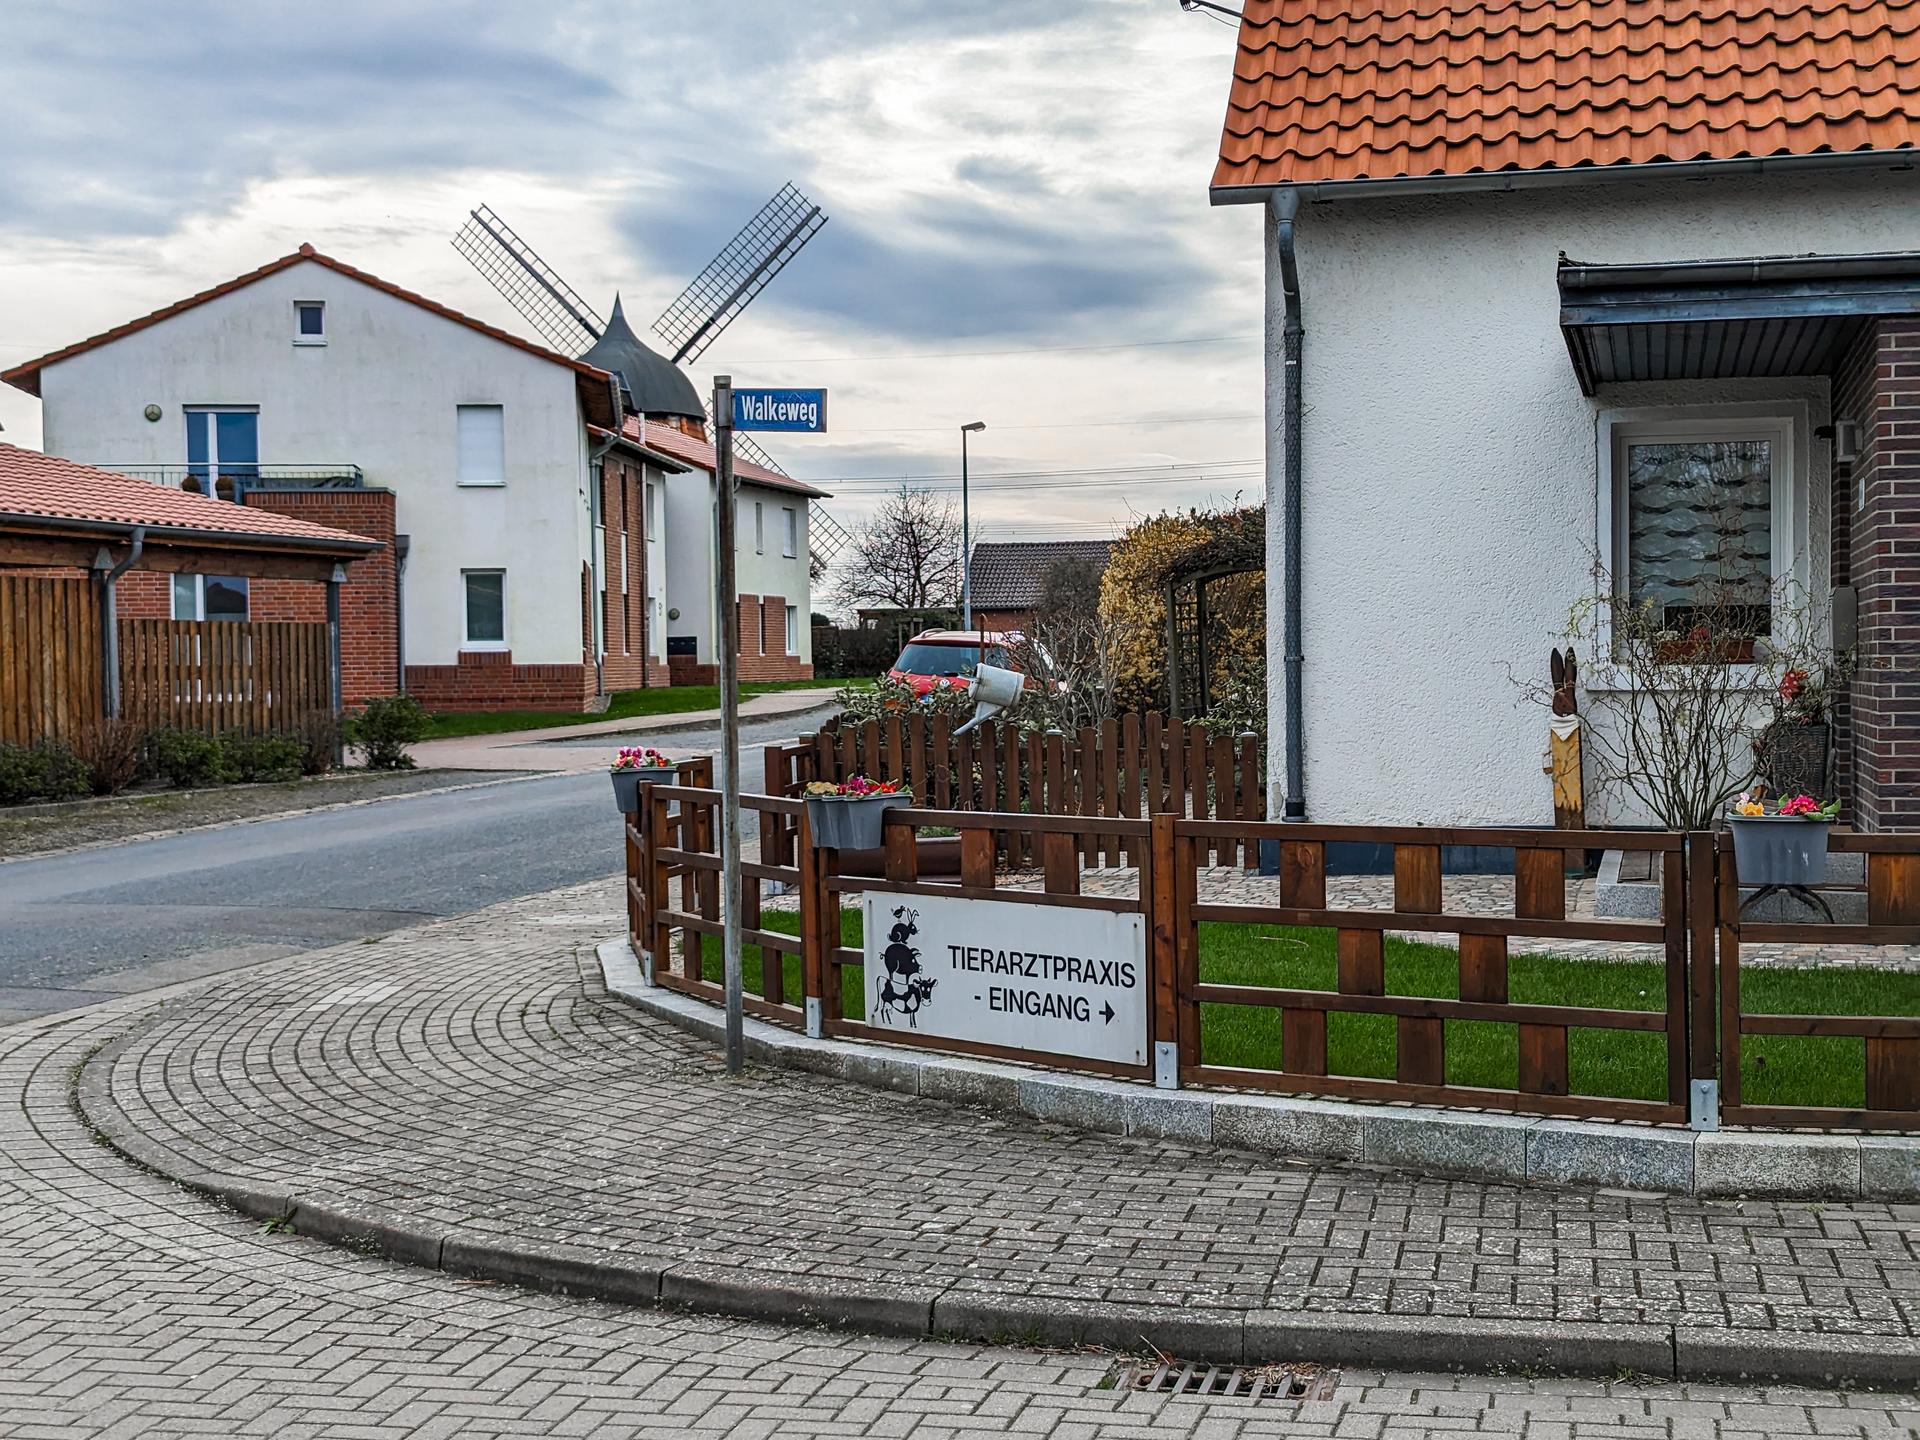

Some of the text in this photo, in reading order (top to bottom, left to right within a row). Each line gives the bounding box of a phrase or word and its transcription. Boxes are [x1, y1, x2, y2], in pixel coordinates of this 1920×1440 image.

[741, 395, 818, 429] Walkeweg
[947, 944, 1136, 989] TIERARZTPRAXIS
[989, 986, 1090, 1022] EINGANG
